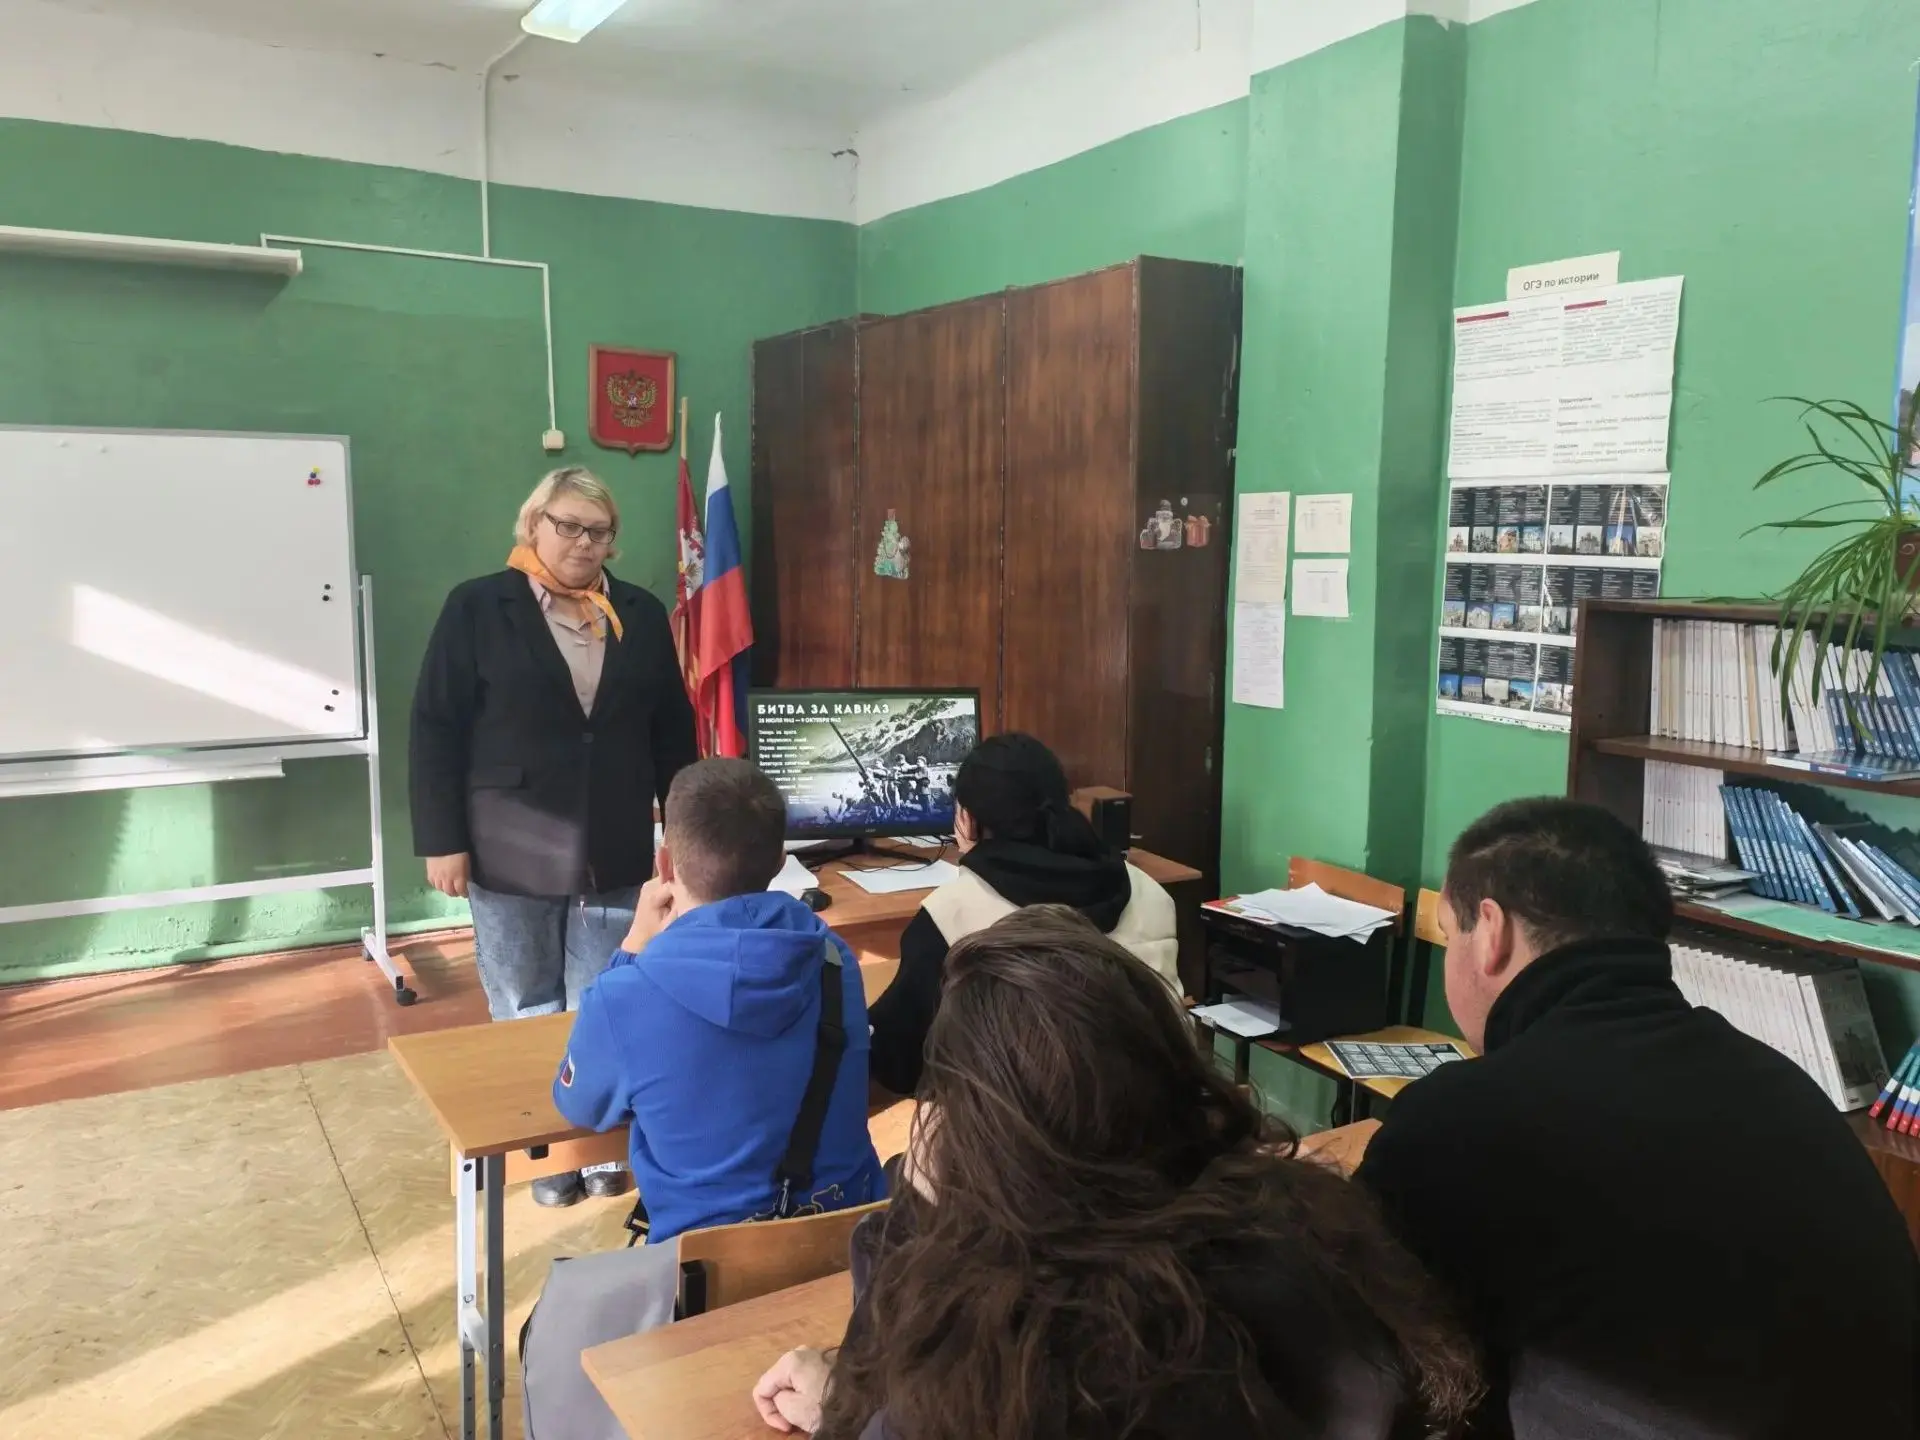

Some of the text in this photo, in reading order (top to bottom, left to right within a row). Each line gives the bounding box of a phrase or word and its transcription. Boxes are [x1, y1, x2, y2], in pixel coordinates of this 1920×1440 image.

[1523, 273, 1600, 291] ОГЭ по истории
[757, 704, 890, 715] БИТВА ЗА КАВКАЗ
